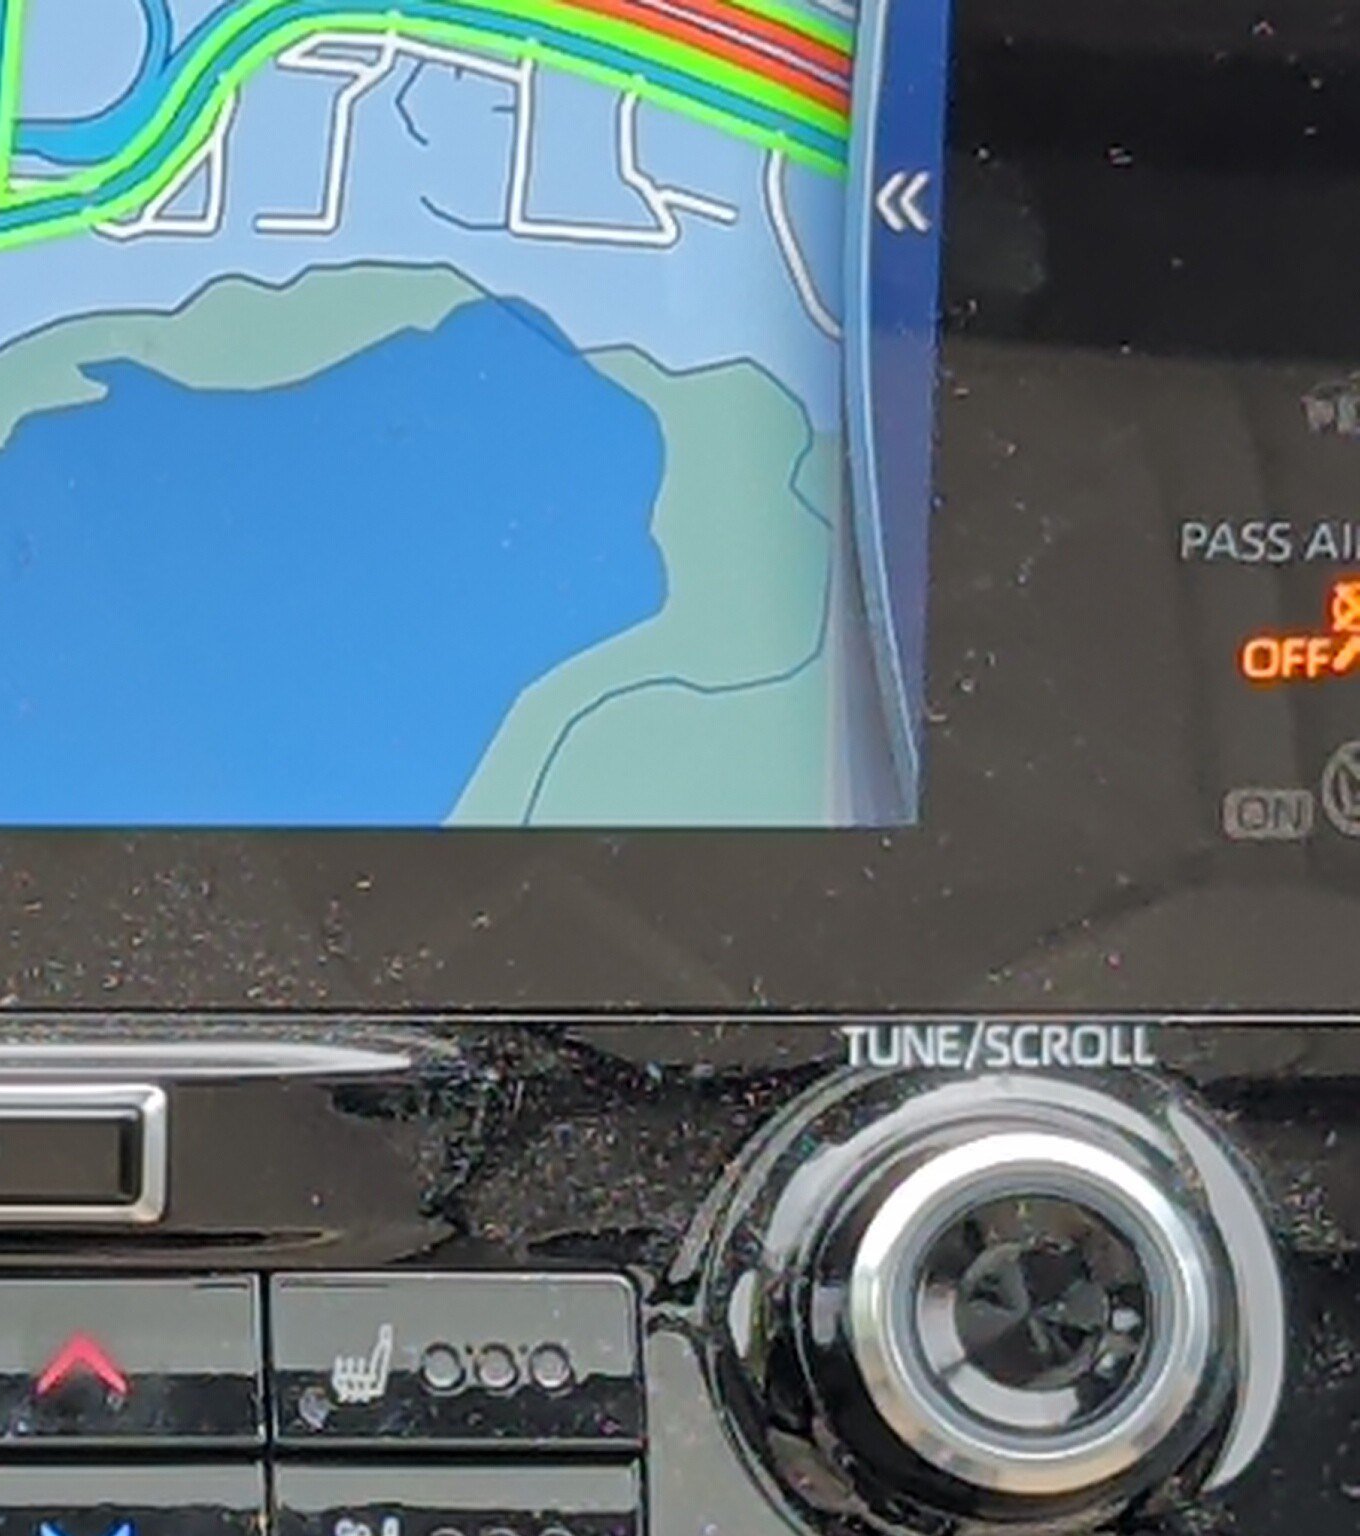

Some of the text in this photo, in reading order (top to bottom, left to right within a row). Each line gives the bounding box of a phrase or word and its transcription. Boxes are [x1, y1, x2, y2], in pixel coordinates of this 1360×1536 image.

[1181, 522, 1360, 561] PASS AI
[1241, 637, 1332, 680] OFF
[1237, 793, 1304, 831] ON
[842, 1024, 1154, 1066] TUNE/SCROLL
